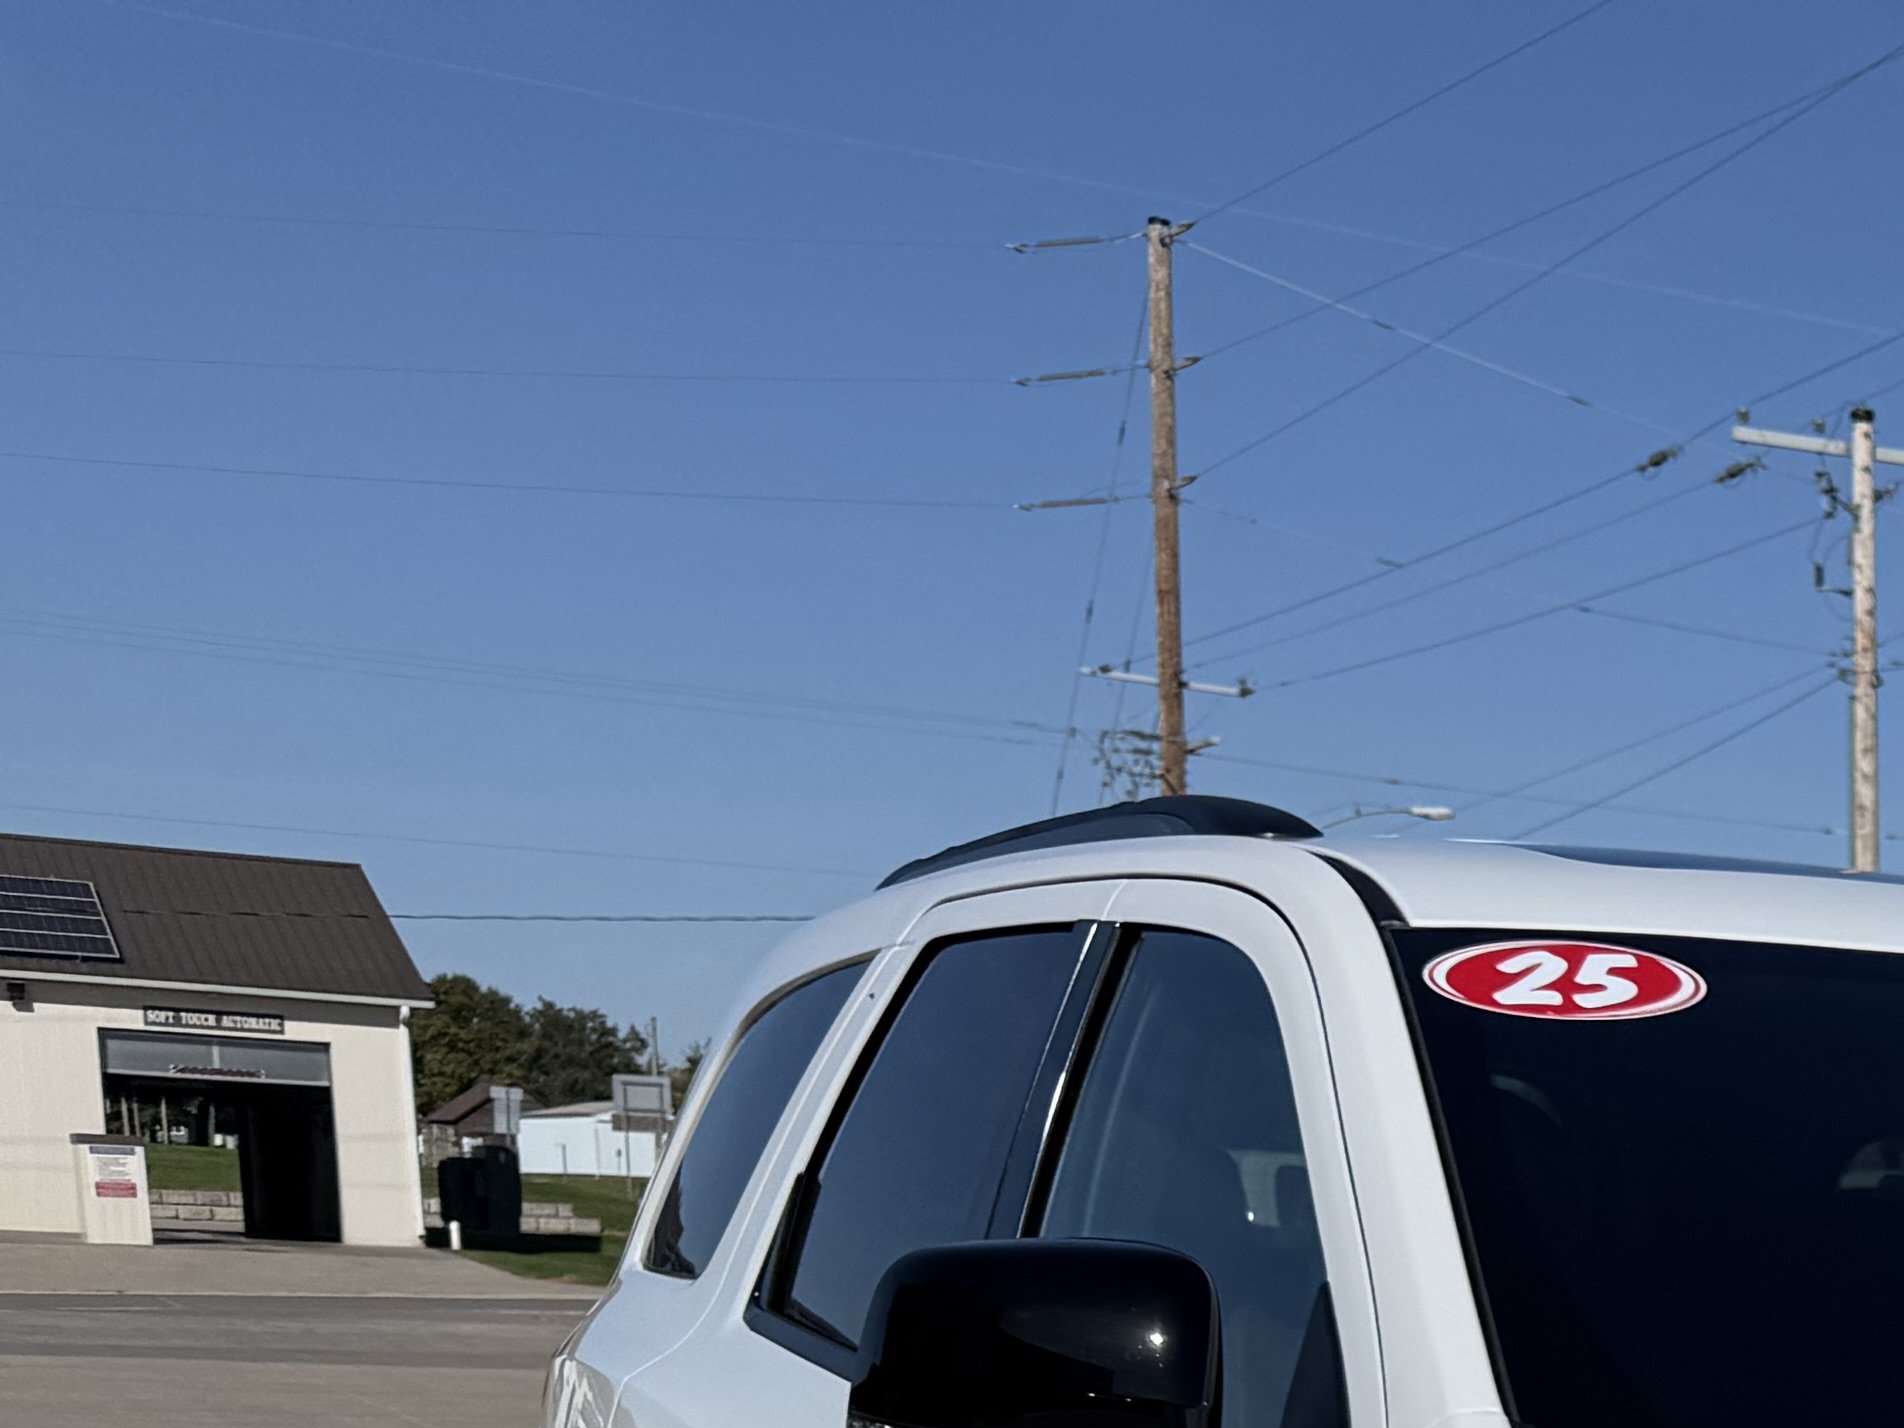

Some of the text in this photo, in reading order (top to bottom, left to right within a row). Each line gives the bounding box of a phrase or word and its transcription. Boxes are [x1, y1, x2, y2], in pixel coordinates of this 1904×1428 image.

[1492, 950, 1638, 1008] 25
[146, 1010, 281, 1030] SOFT TOUCH AUTOMATIC
